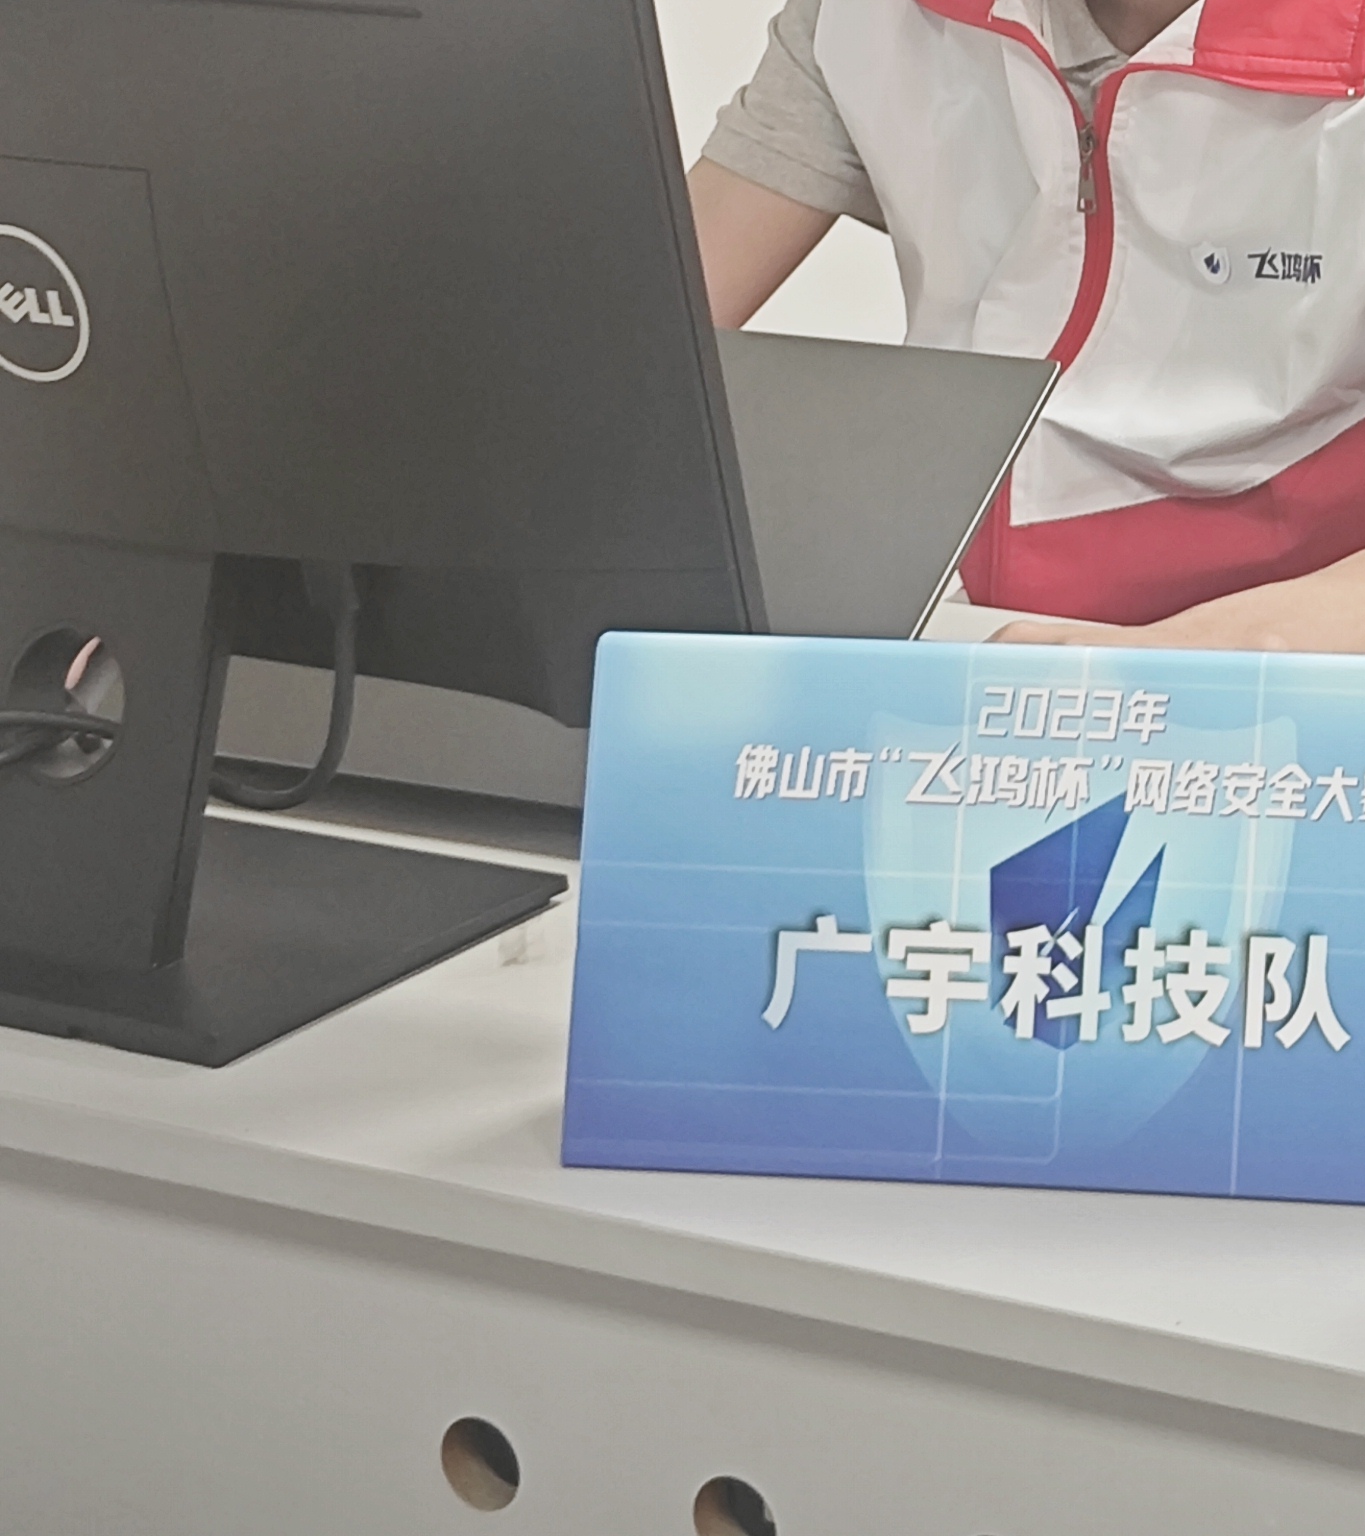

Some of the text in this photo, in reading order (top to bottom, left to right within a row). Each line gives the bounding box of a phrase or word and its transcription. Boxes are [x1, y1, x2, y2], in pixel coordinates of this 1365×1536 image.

[1247, 246, 1323, 287] 飞鸿杯
[0, 282, 75, 327] ELL
[977, 686, 1170, 744] 2023年
[761, 914, 1351, 1052] 广宇科技队
